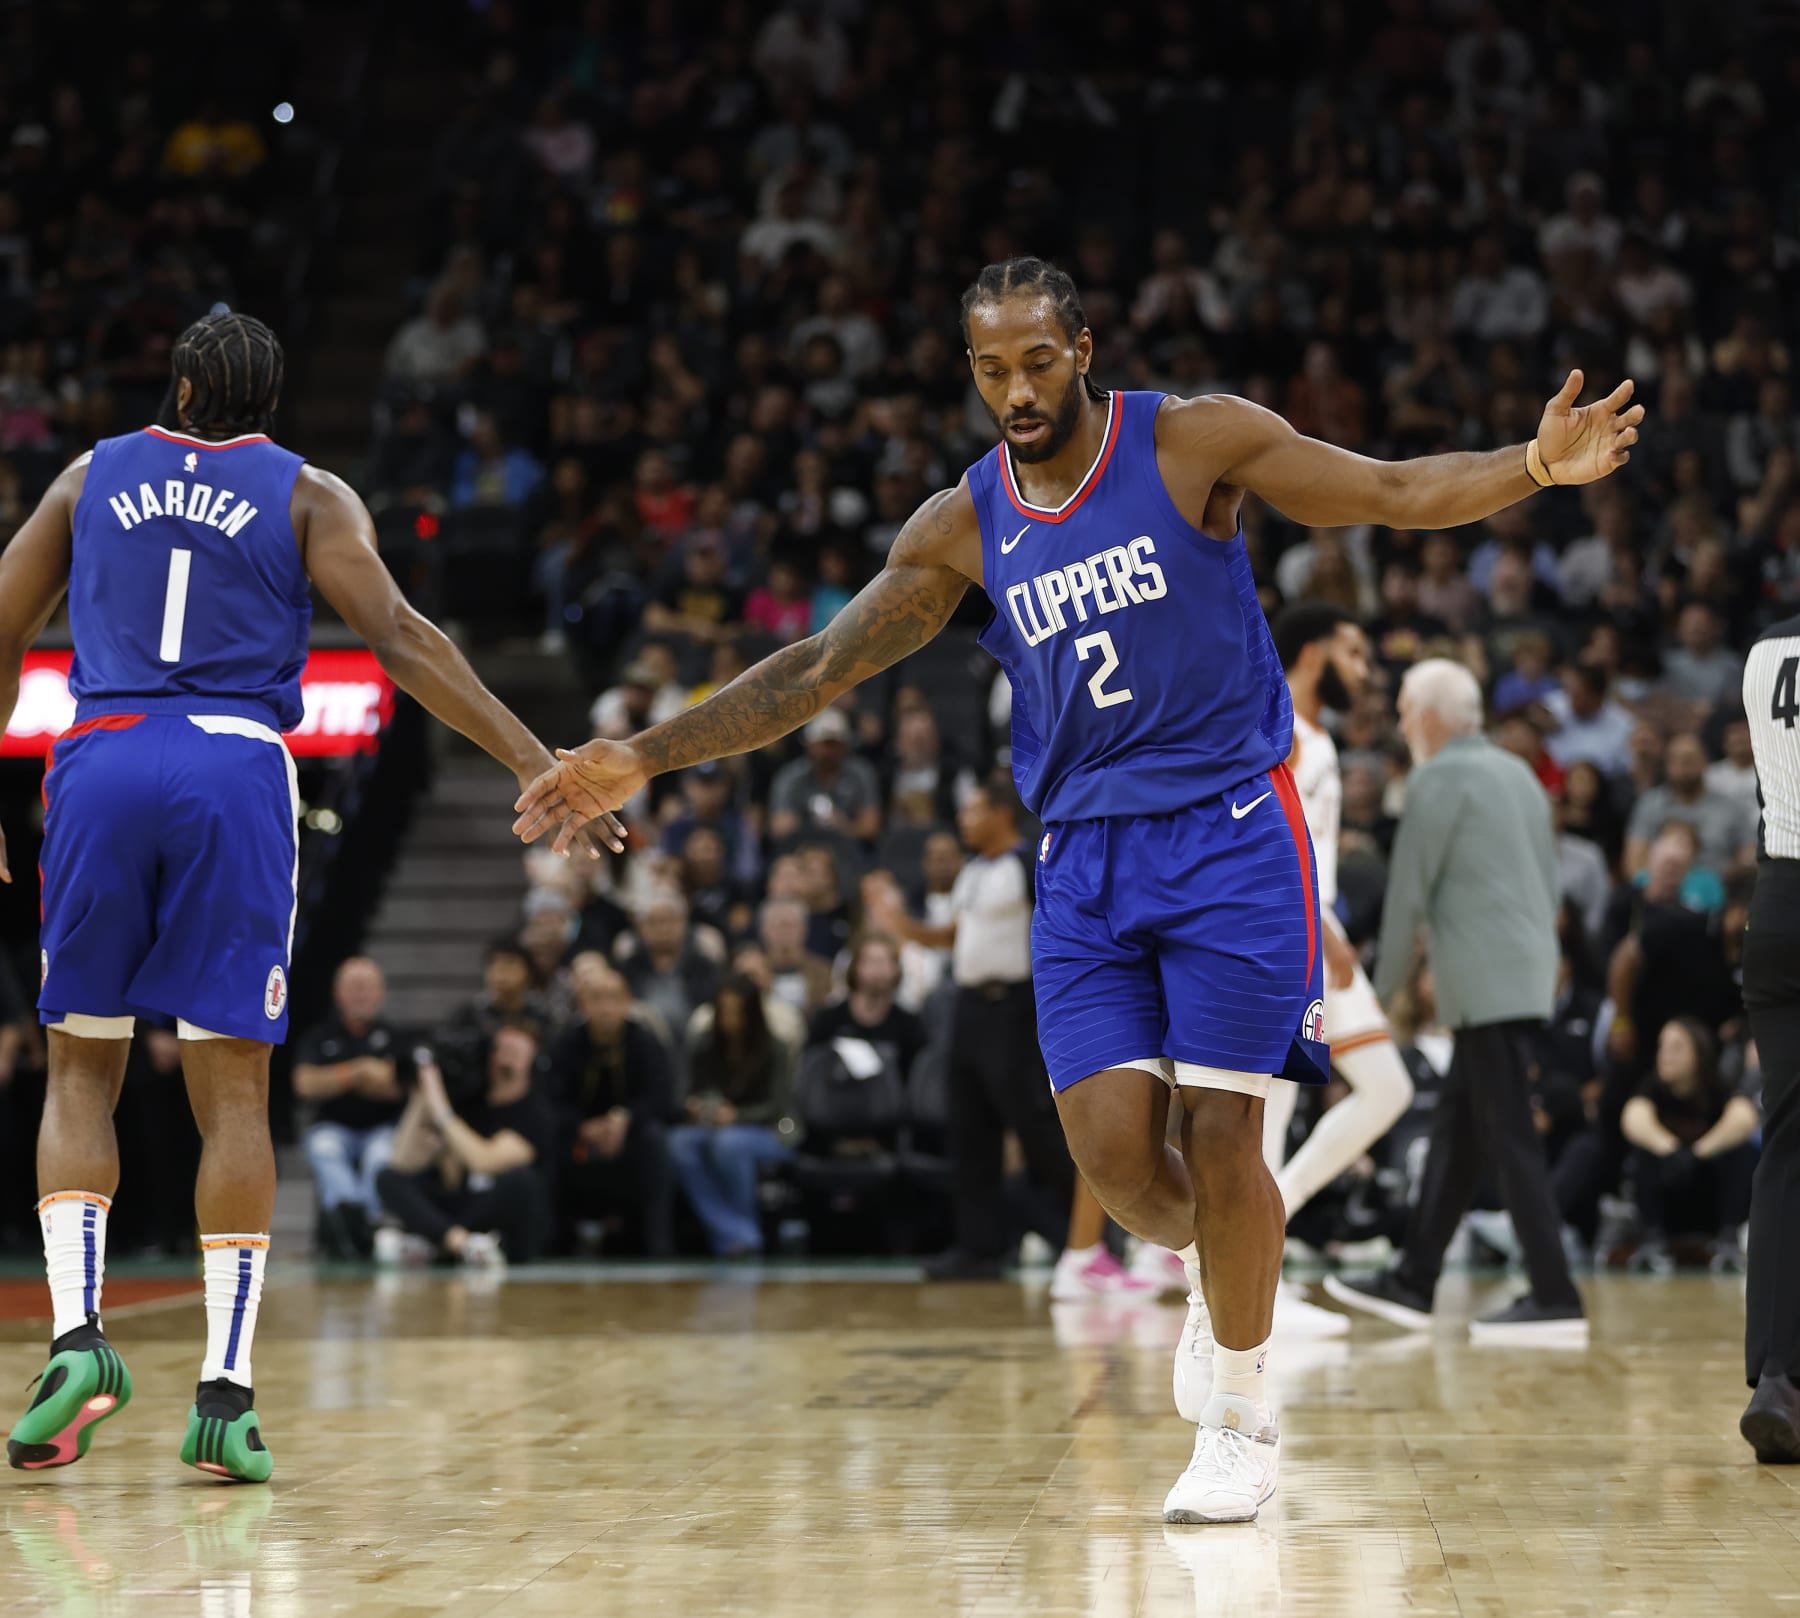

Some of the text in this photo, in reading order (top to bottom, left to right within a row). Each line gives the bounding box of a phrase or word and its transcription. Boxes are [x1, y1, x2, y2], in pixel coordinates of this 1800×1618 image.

[109, 480, 259, 538] HARDEN
[160, 549, 192, 662] 1
[1007, 536, 1168, 647] CLIPPERS
[1074, 631, 1133, 709] 2
